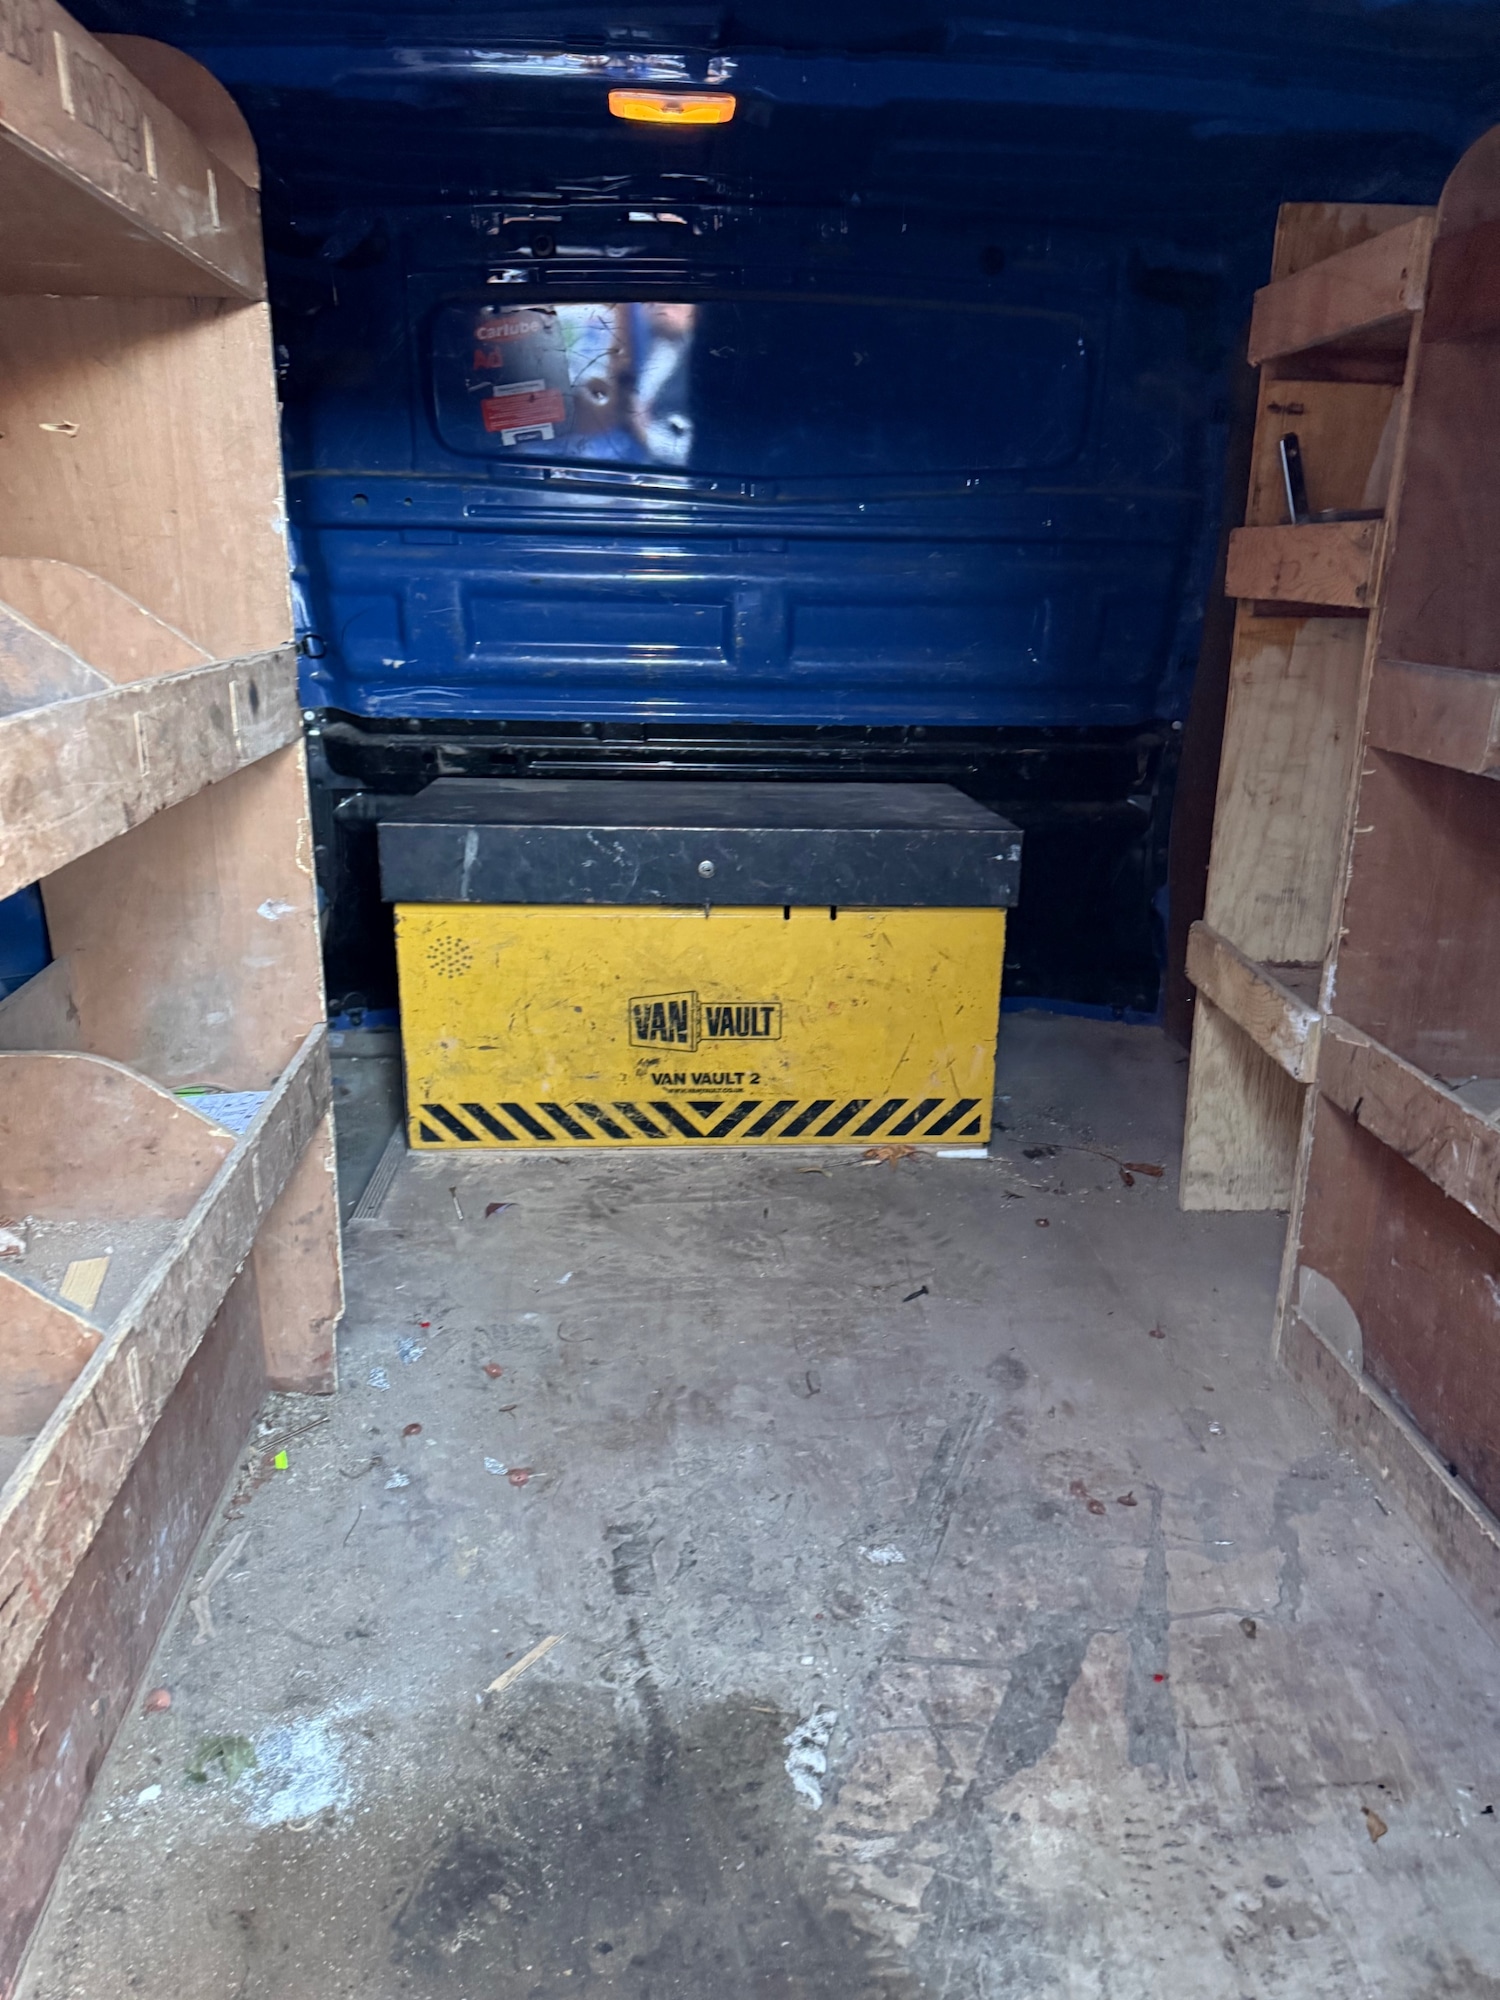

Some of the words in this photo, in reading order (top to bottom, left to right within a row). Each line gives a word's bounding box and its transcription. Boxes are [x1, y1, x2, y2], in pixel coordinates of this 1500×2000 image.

[476, 320, 540, 340] Carlube
[633, 999, 688, 1043] VAN
[706, 1006, 775, 1036] VAULT
[651, 1072, 686, 1085] VAN
[691, 1072, 745, 1085] VAULT
[749, 1073, 760, 1085] 2
